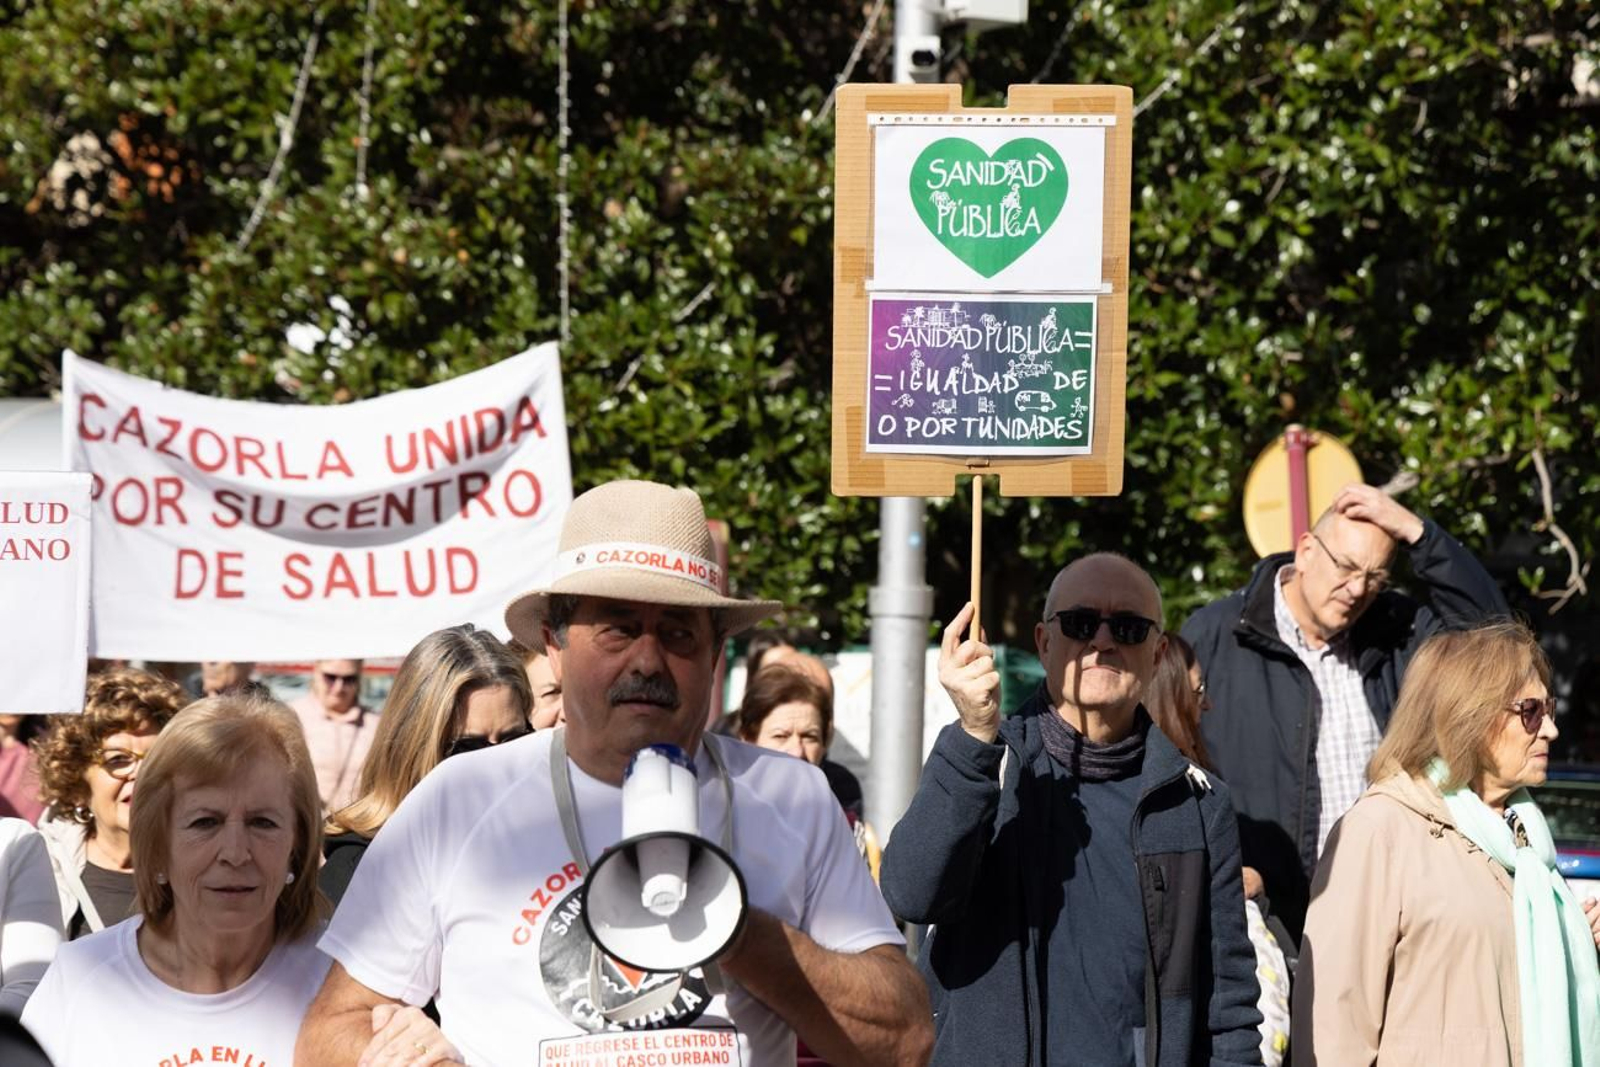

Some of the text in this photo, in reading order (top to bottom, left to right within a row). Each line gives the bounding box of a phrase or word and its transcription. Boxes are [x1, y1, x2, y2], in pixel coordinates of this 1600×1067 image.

[926, 156, 1047, 189] SANIDAD
[937, 199, 1041, 238] PÚBLICA
[885, 325, 982, 351] SANIDAD
[900, 367, 1019, 395] IGUALDAD
[1054, 370, 1087, 390] DE
[77, 392, 547, 480] CAZORLA UNIDA
[0, 502, 69, 524] LUD
[212, 489, 285, 529] SU
[305, 469, 542, 530] CENTRO
[0, 538, 71, 561] ANO
[175, 546, 479, 600] DE SALUD
[596, 550, 685, 573] CAZORLA
[688, 561, 707, 579] NO
[551, 893, 582, 935] SAN
[211, 1046, 239, 1064] EN
[545, 1032, 734, 1060] QUE REGRESE EL CENTRO DE
[616, 1052, 667, 1067] CASCO
[671, 1050, 730, 1065] URBANO
